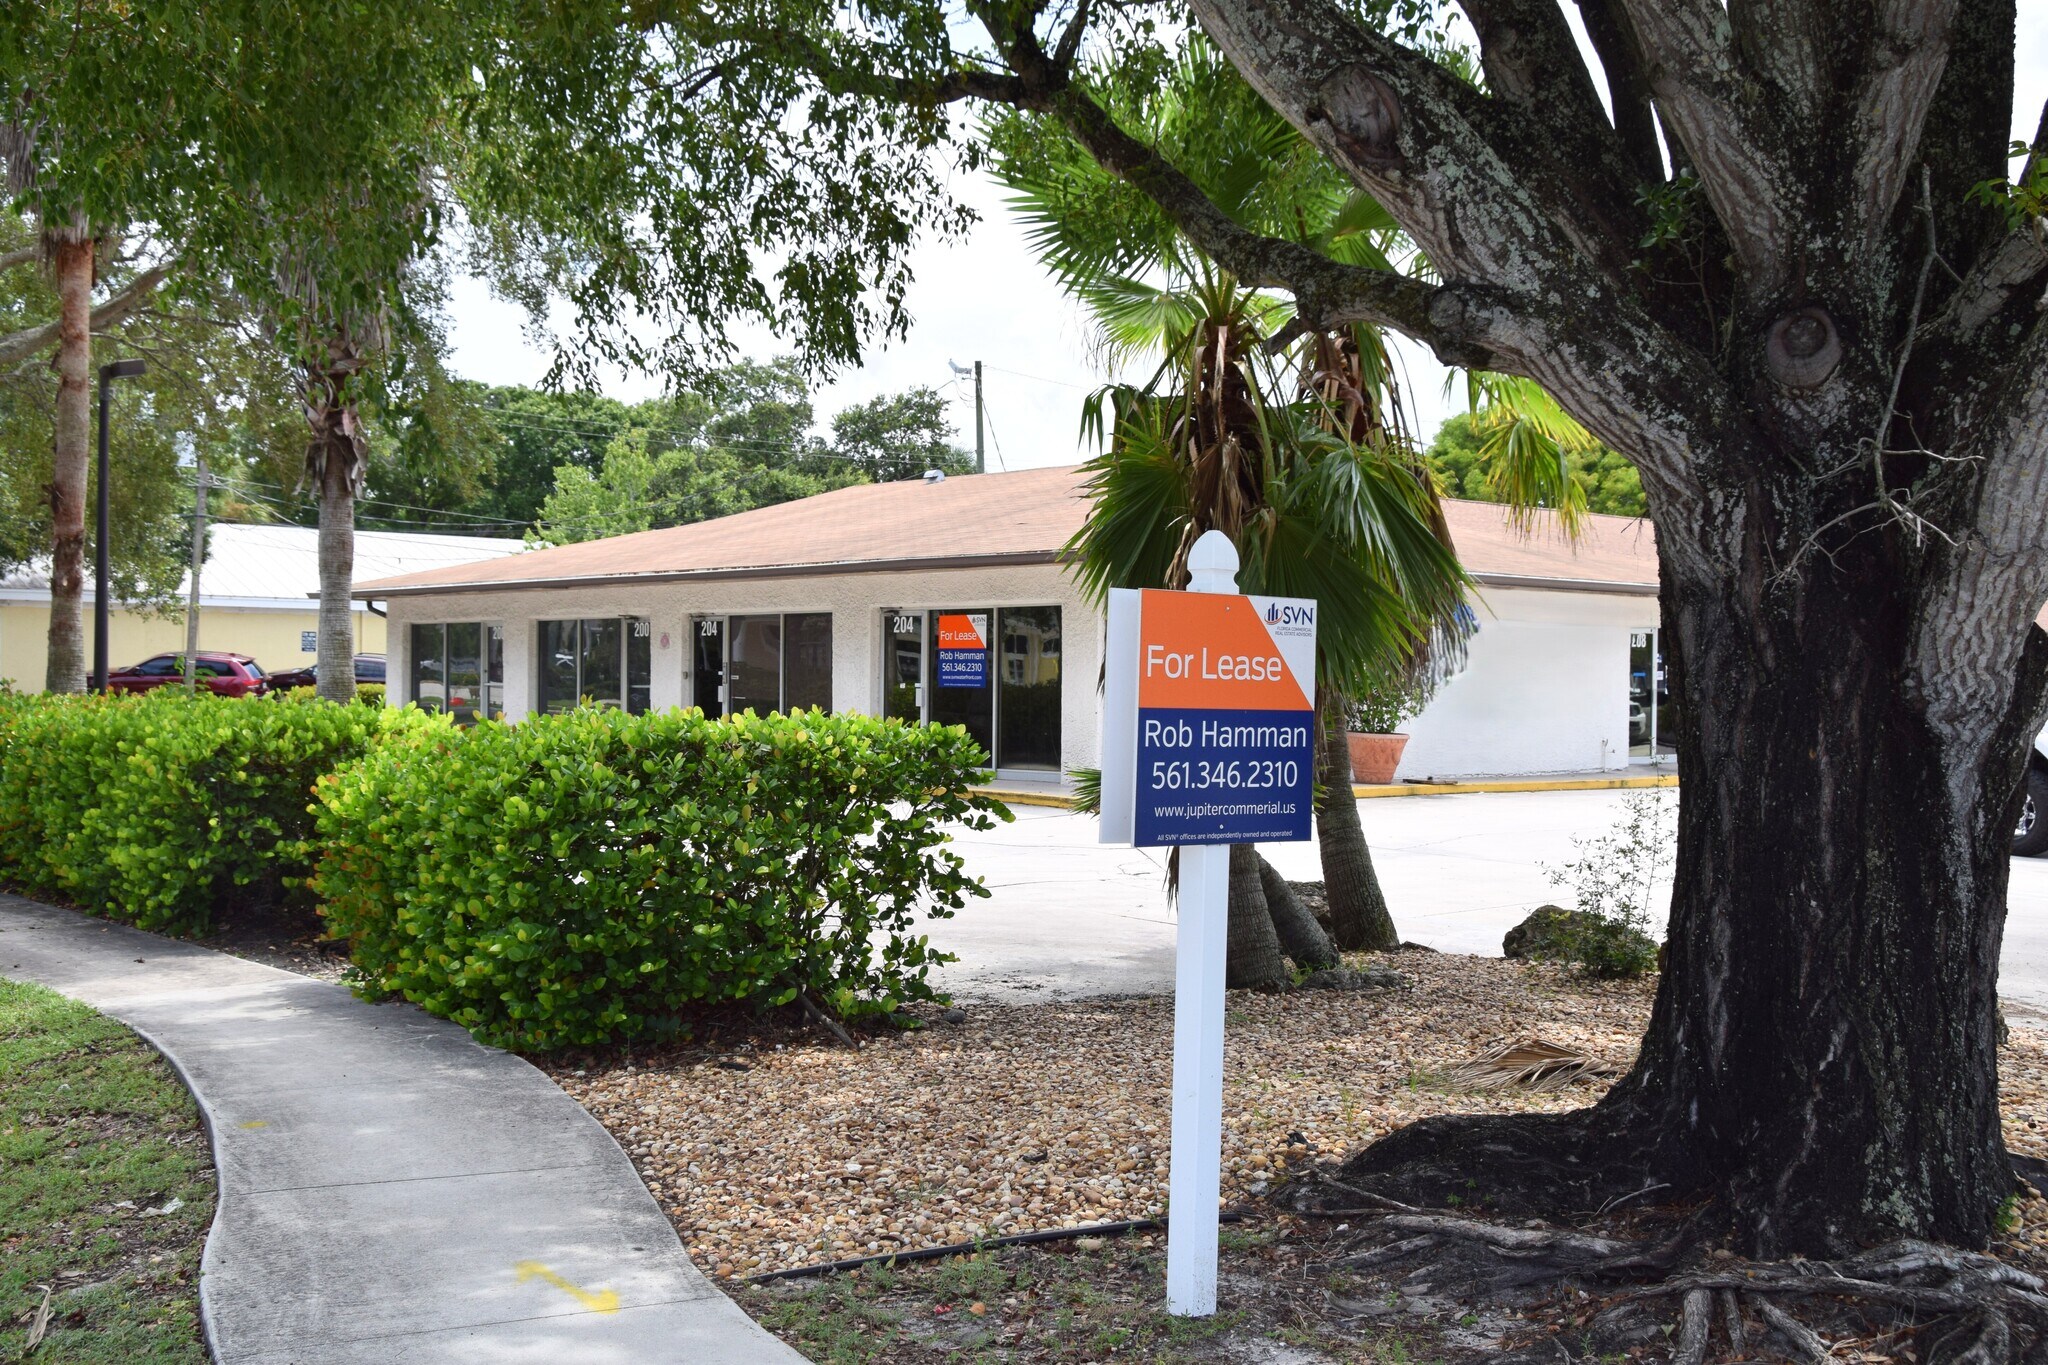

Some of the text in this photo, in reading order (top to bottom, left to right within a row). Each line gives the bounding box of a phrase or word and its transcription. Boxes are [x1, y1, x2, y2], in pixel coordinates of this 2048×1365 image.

[1283, 605, 1313, 626] SVN
[634, 622, 650, 637] 200
[701, 621, 717, 636] 204
[893, 616, 914, 633] 204
[491, 625, 504, 640] 20
[940, 630, 977, 641] For Lease
[940, 651, 985, 660] Rob Hamman
[1146, 644, 1282, 682] For Lease
[942, 662, 982, 672] 561.346.2310
[1144, 719, 1307, 748] Rob Hamman
[1151, 760, 1299, 790] 561.346.2310
[1154, 801, 1296, 820] www.jupitercommerial.us
[1179, 833, 1197, 841] offices
[1206, 831, 1242, 840] independently
[1242, 831, 1260, 839] owned
[1260, 830, 1270, 838] and
[1270, 830, 1293, 839] operated
